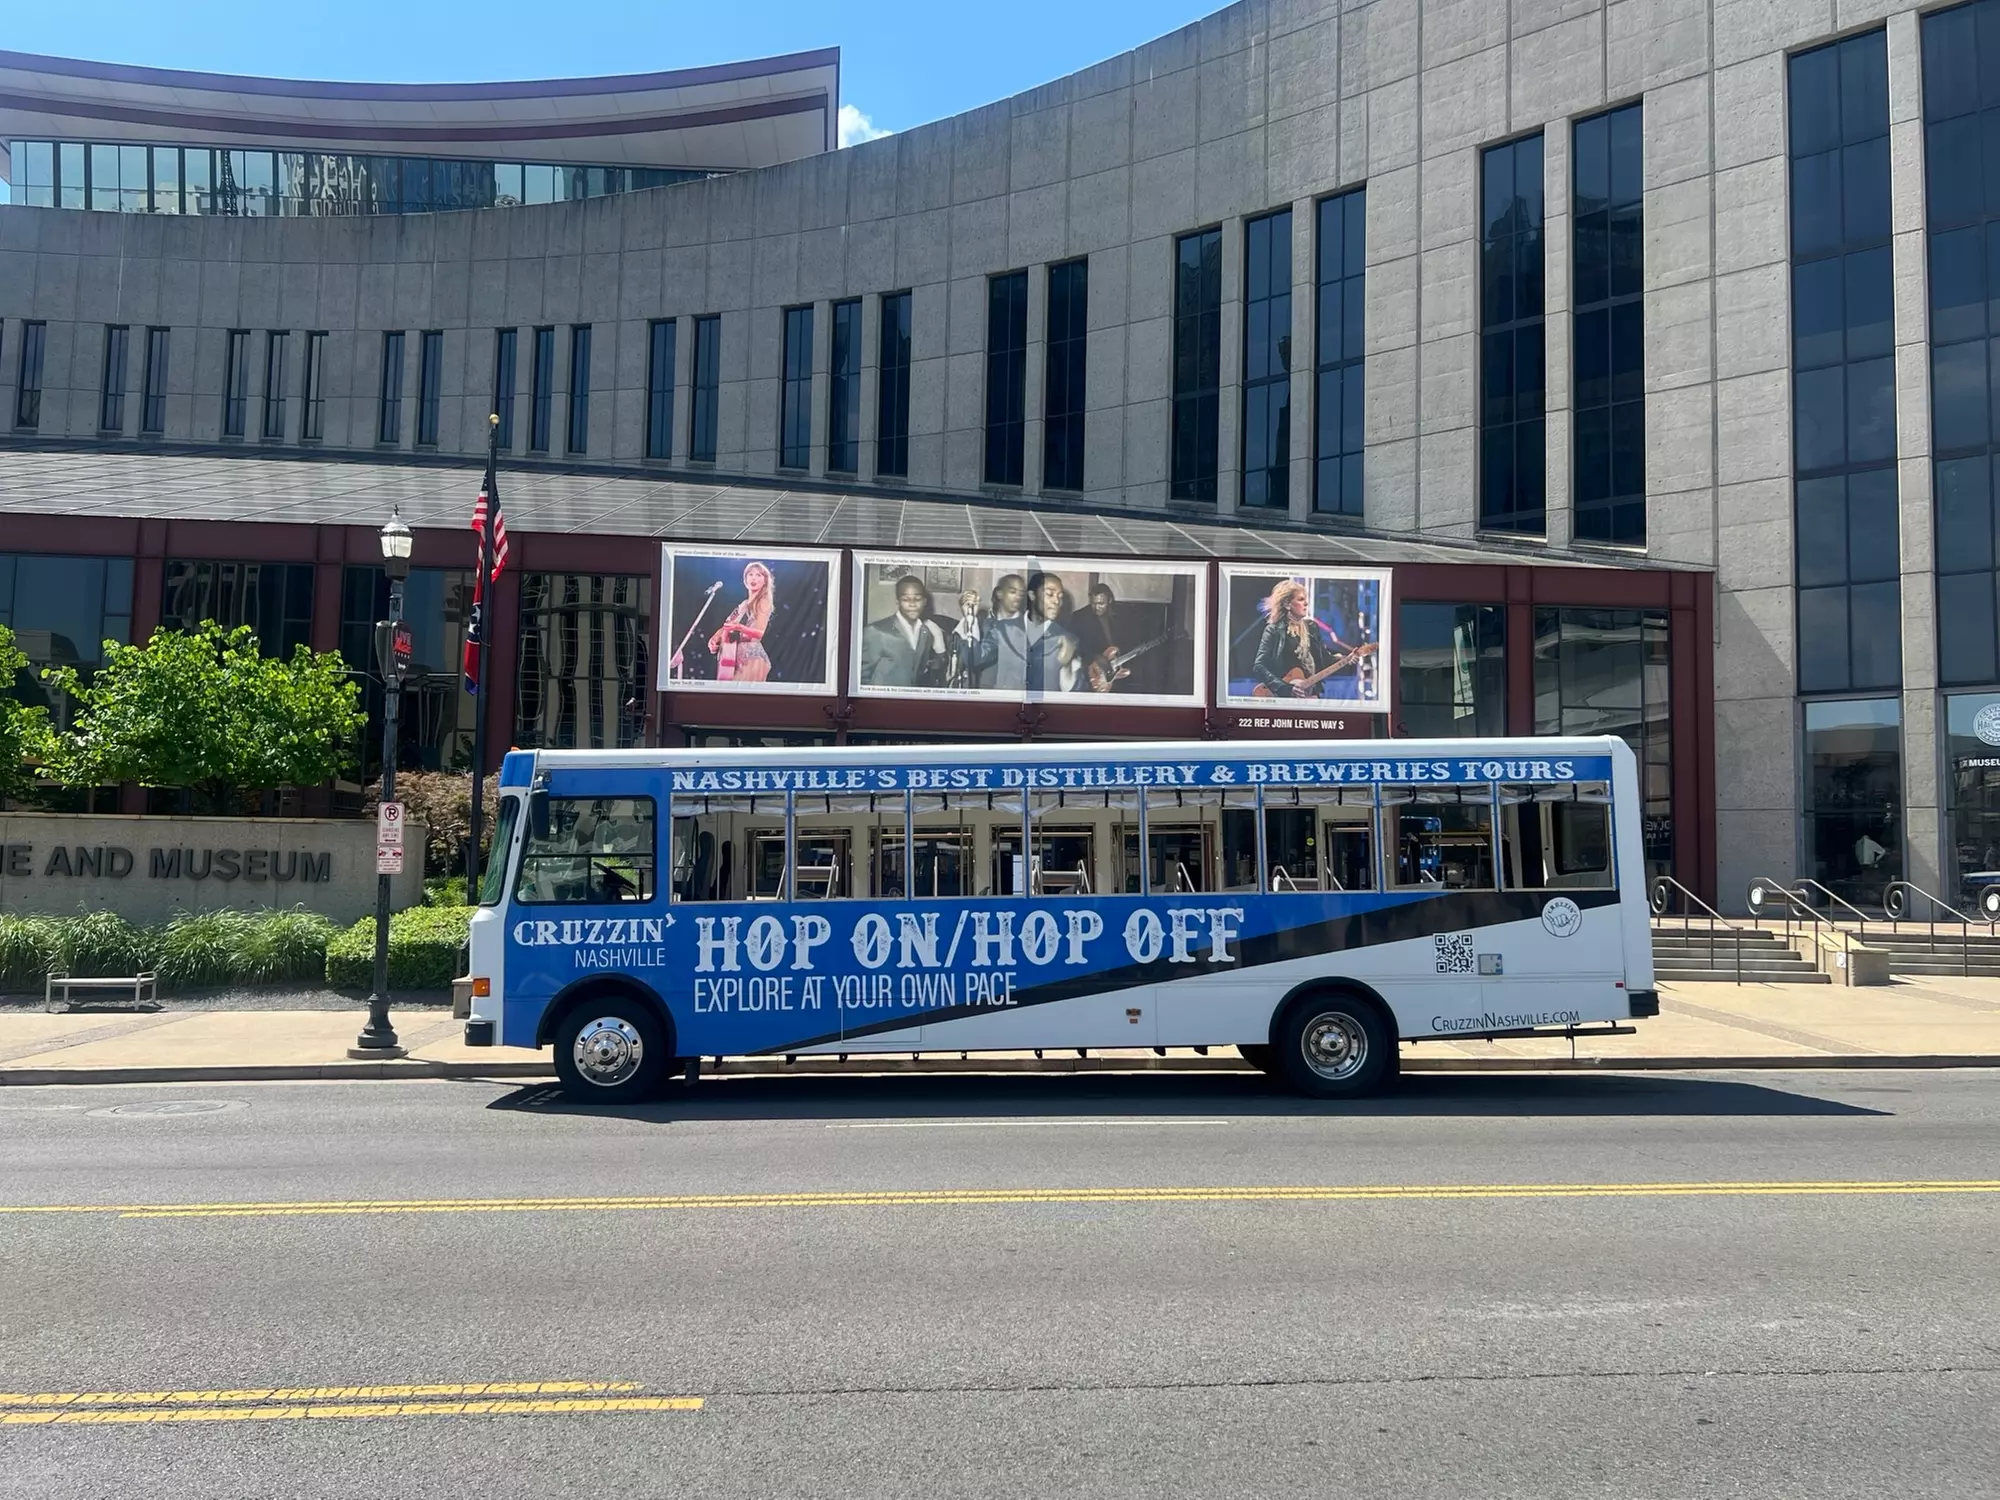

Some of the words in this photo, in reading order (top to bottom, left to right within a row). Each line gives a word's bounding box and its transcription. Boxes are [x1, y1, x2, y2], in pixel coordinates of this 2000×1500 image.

[1238, 718, 1253, 728] 222
[1254, 718, 1270, 728] REP.
[1271, 718, 1293, 729] JOHN
[1294, 719, 1319, 730] LEWIS
[1320, 719, 1338, 730] WAY
[1338, 720, 1345, 730] S
[671, 769, 897, 790] NASHVILLE'S
[906, 769, 993, 788] BEST
[1002, 765, 1199, 787] DISTILLERY
[1209, 765, 1235, 783] &
[1246, 762, 1450, 783] BREWERIES
[1459, 760, 1575, 781] TOURS
[0, 844, 32, 877] E
[44, 846, 134, 879] AND
[149, 847, 331, 883] MUSEUM
[513, 913, 677, 946] CRUZZIN'
[694, 914, 831, 972] HOP
[1122, 907, 1245, 964] OFF
[575, 948, 665, 968] NASHVILLE
[694, 976, 793, 1013] EXPLORE
[801, 975, 826, 1010] AT
[832, 974, 893, 1008] YOUR
[901, 972, 955, 1008] OWN
[965, 971, 1018, 1006] PACE
